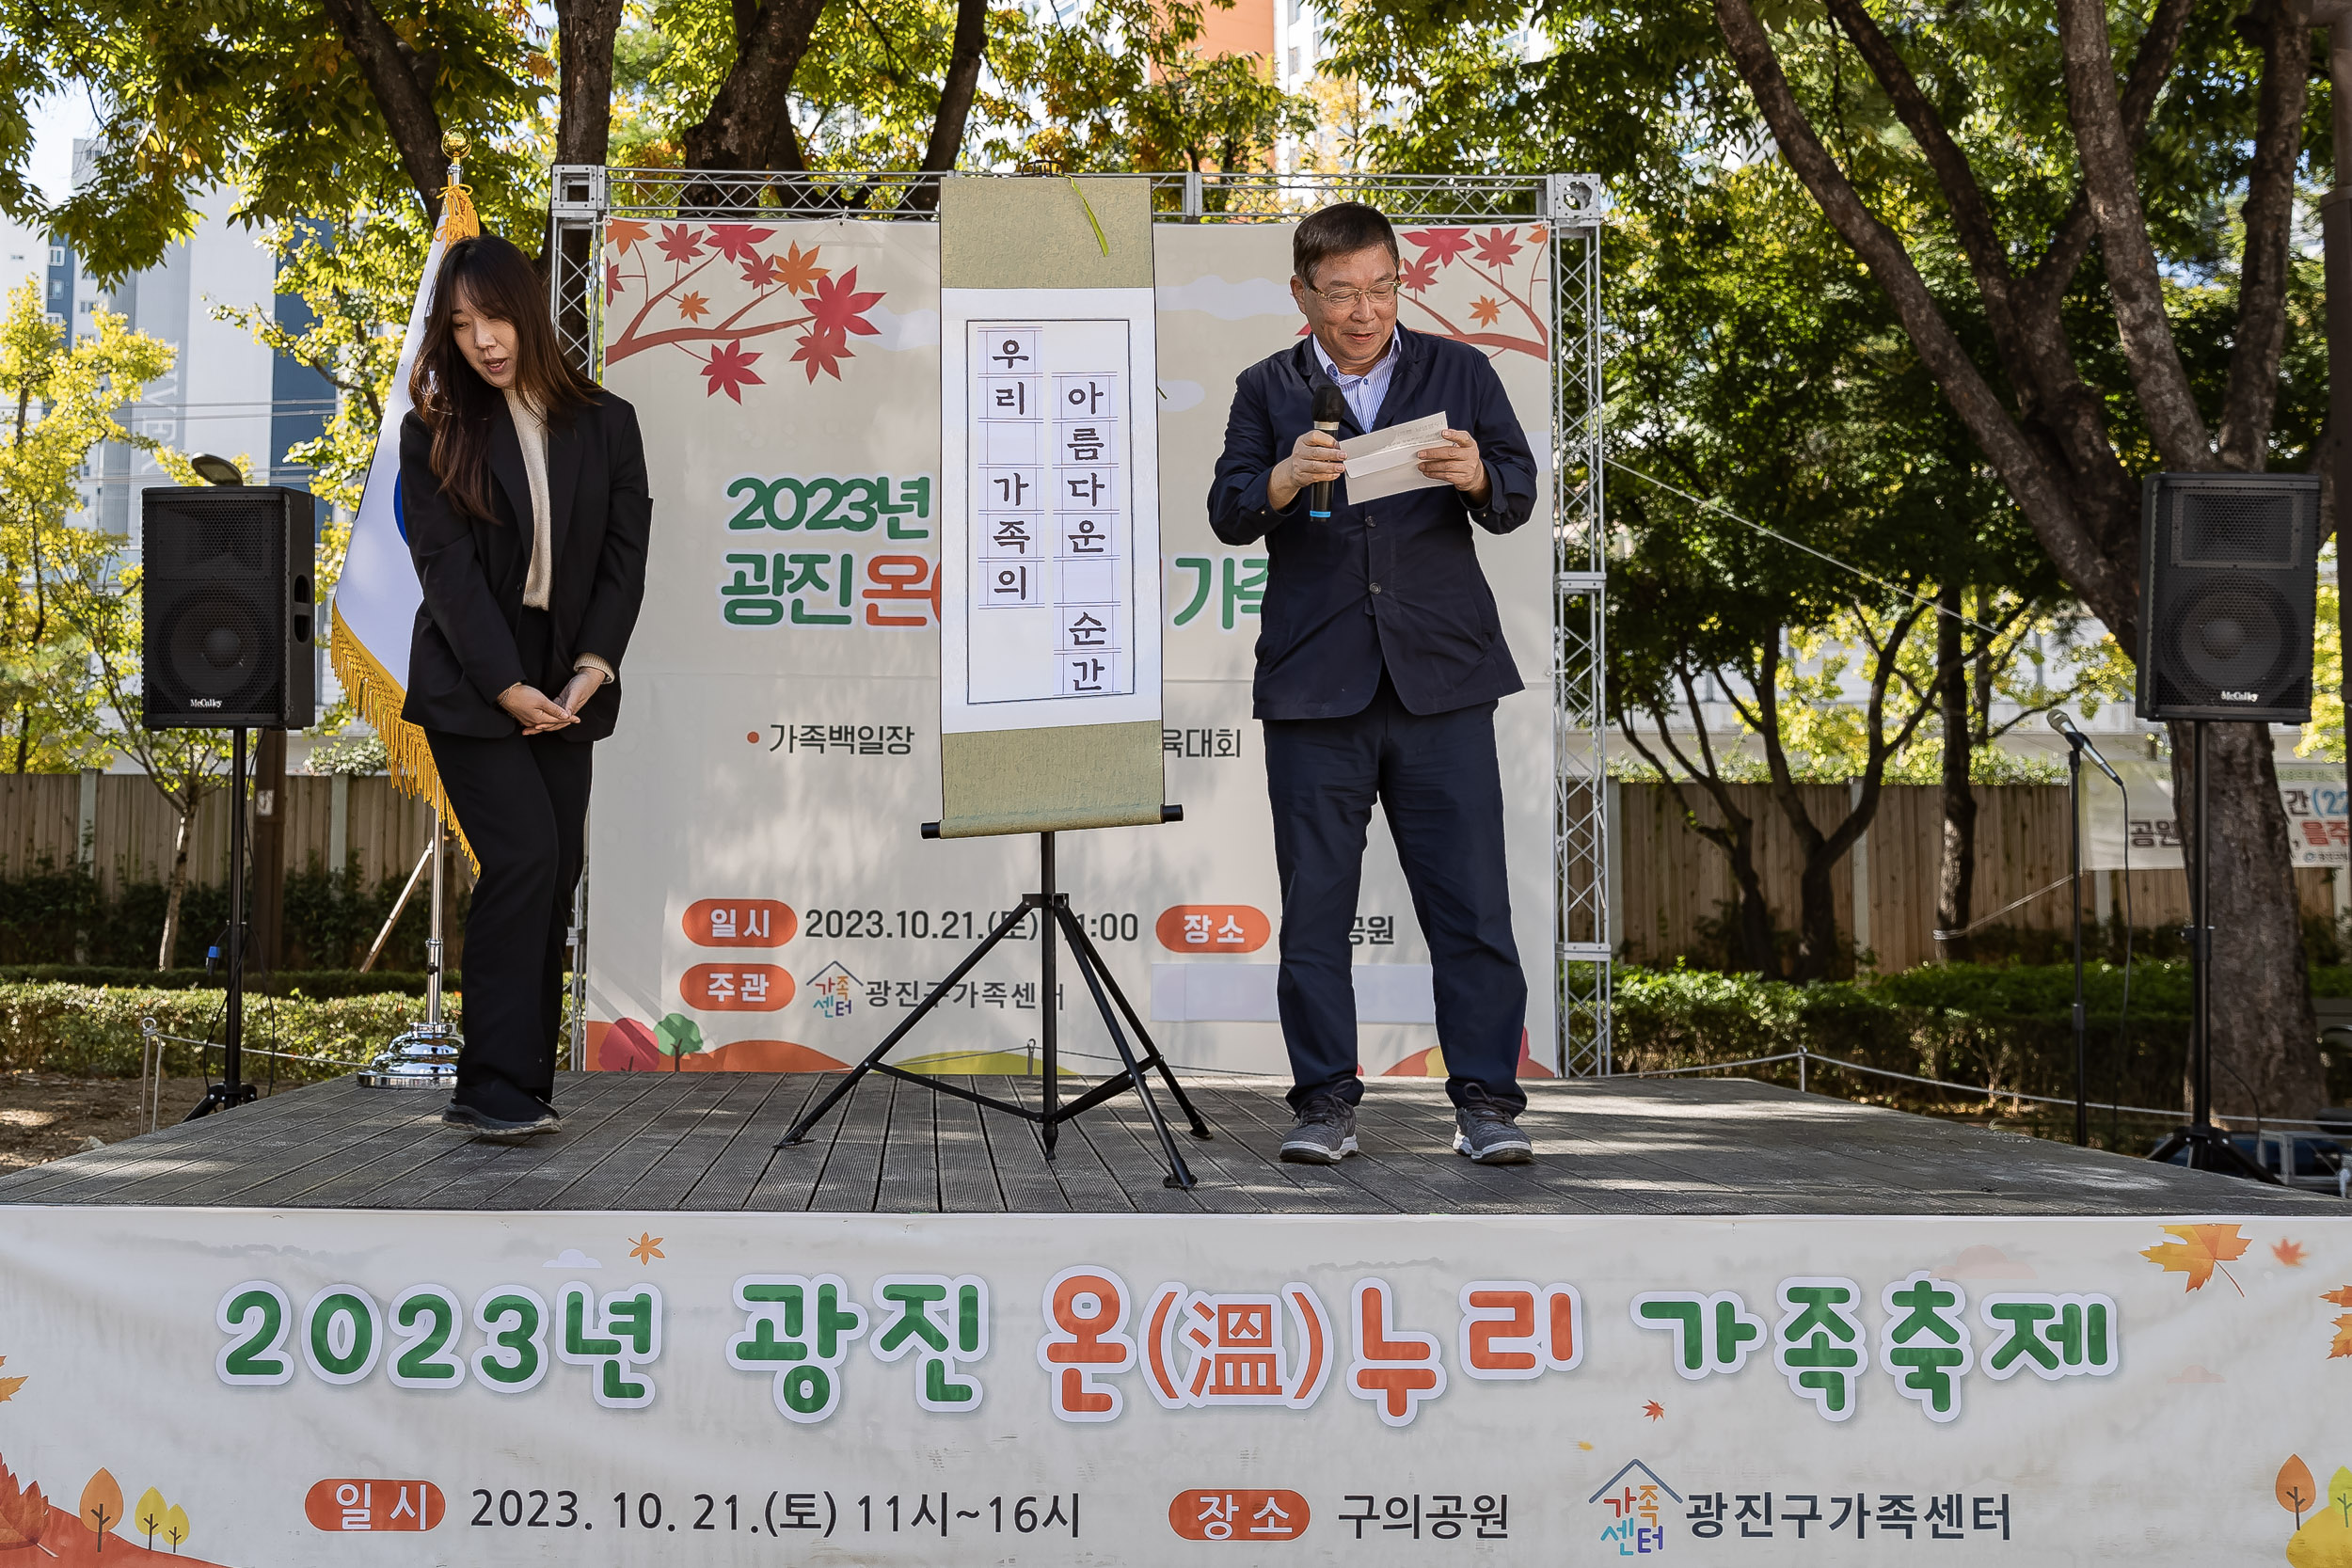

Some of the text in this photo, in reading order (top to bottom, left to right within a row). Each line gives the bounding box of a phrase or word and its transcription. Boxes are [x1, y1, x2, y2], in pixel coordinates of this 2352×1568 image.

[992, 339, 1031, 601] 우리 가족의
[726, 475, 930, 540] 2023년
[1066, 381, 1107, 691] 아름다운 순간
[721, 553, 853, 626] 광진
[769, 724, 915, 755] 가족백일장
[707, 973, 770, 1003] 주관
[224, 1288, 654, 1402] 2023년
[735, 1282, 981, 1415] 광진
[1640, 1280, 2107, 1413] 가족축제
[857, 1492, 1080, 1539] 11시~16시
[1338, 1493, 1509, 1540] 구의공원
[1603, 1485, 1660, 1528] 가족
[1686, 1492, 2012, 1541] 광진구가족센터
[1600, 1517, 1663, 1556] 센터
